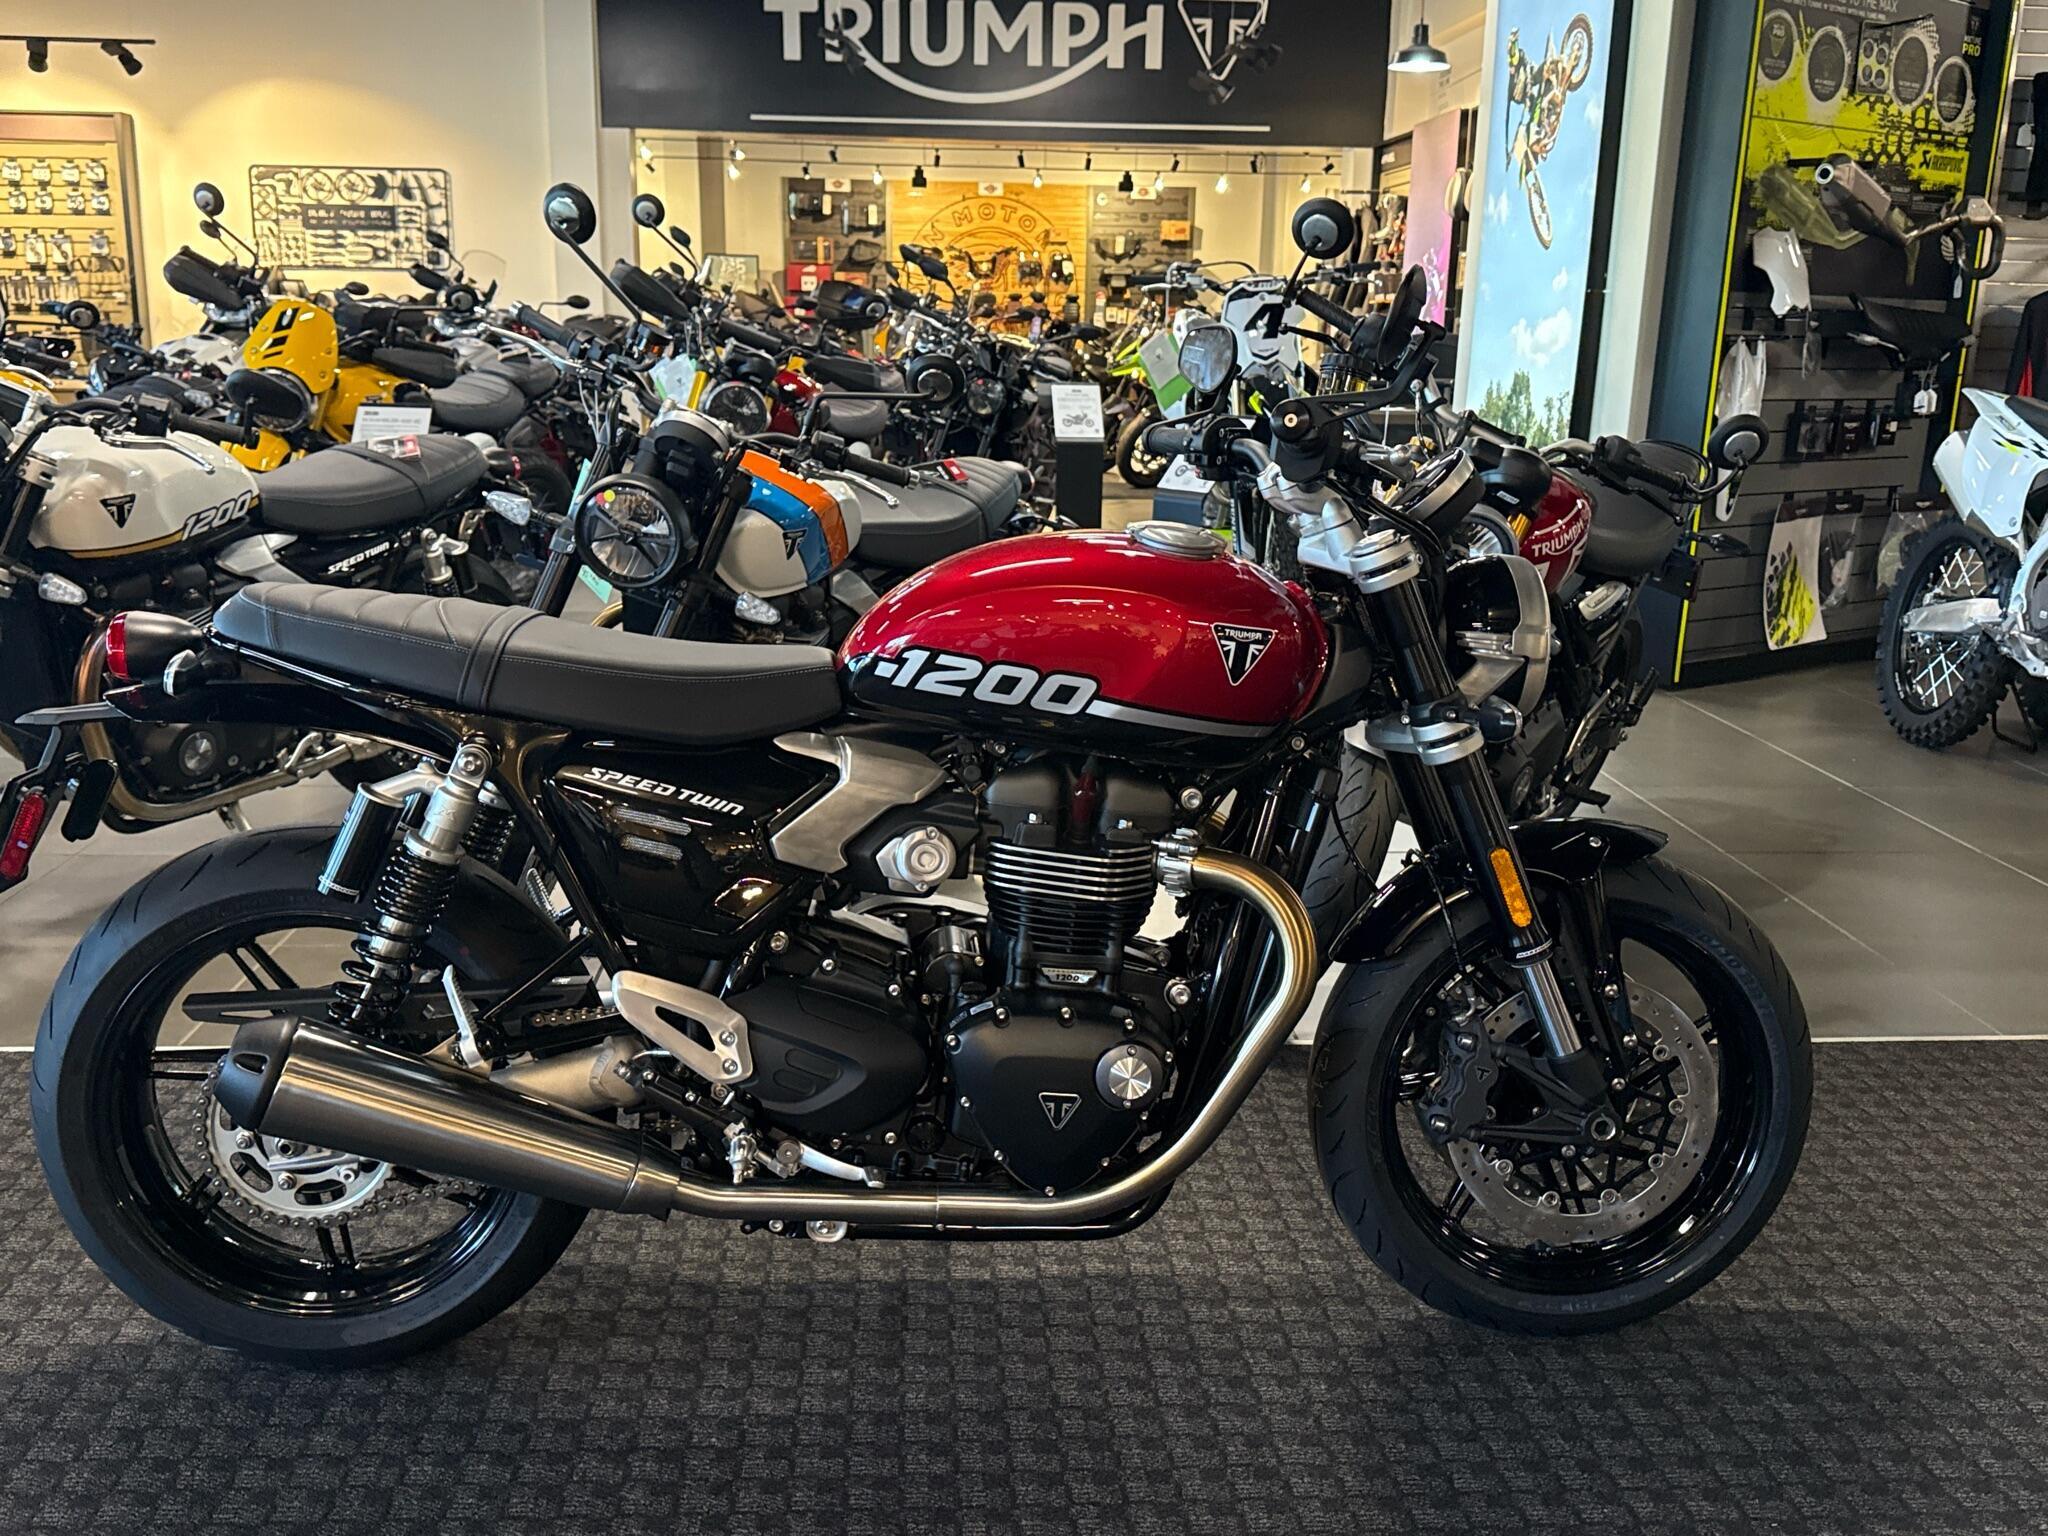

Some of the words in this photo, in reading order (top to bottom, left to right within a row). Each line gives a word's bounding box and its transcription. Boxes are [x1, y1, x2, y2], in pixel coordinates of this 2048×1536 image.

[763, 0, 1164, 103] TRIUMPH
[1962, 42, 1981, 56] PRO
[1244, 303, 1285, 339] 4
[181, 490, 253, 541] 1200
[1531, 519, 1585, 557] TRIUMPH
[327, 552, 364, 575] SPEED
[364, 542, 390, 559] TWIN
[1224, 628, 1262, 642] TRIUMPH
[891, 648, 1098, 715] 1200
[584, 766, 678, 796] SPEED
[677, 788, 745, 816] TWIN
